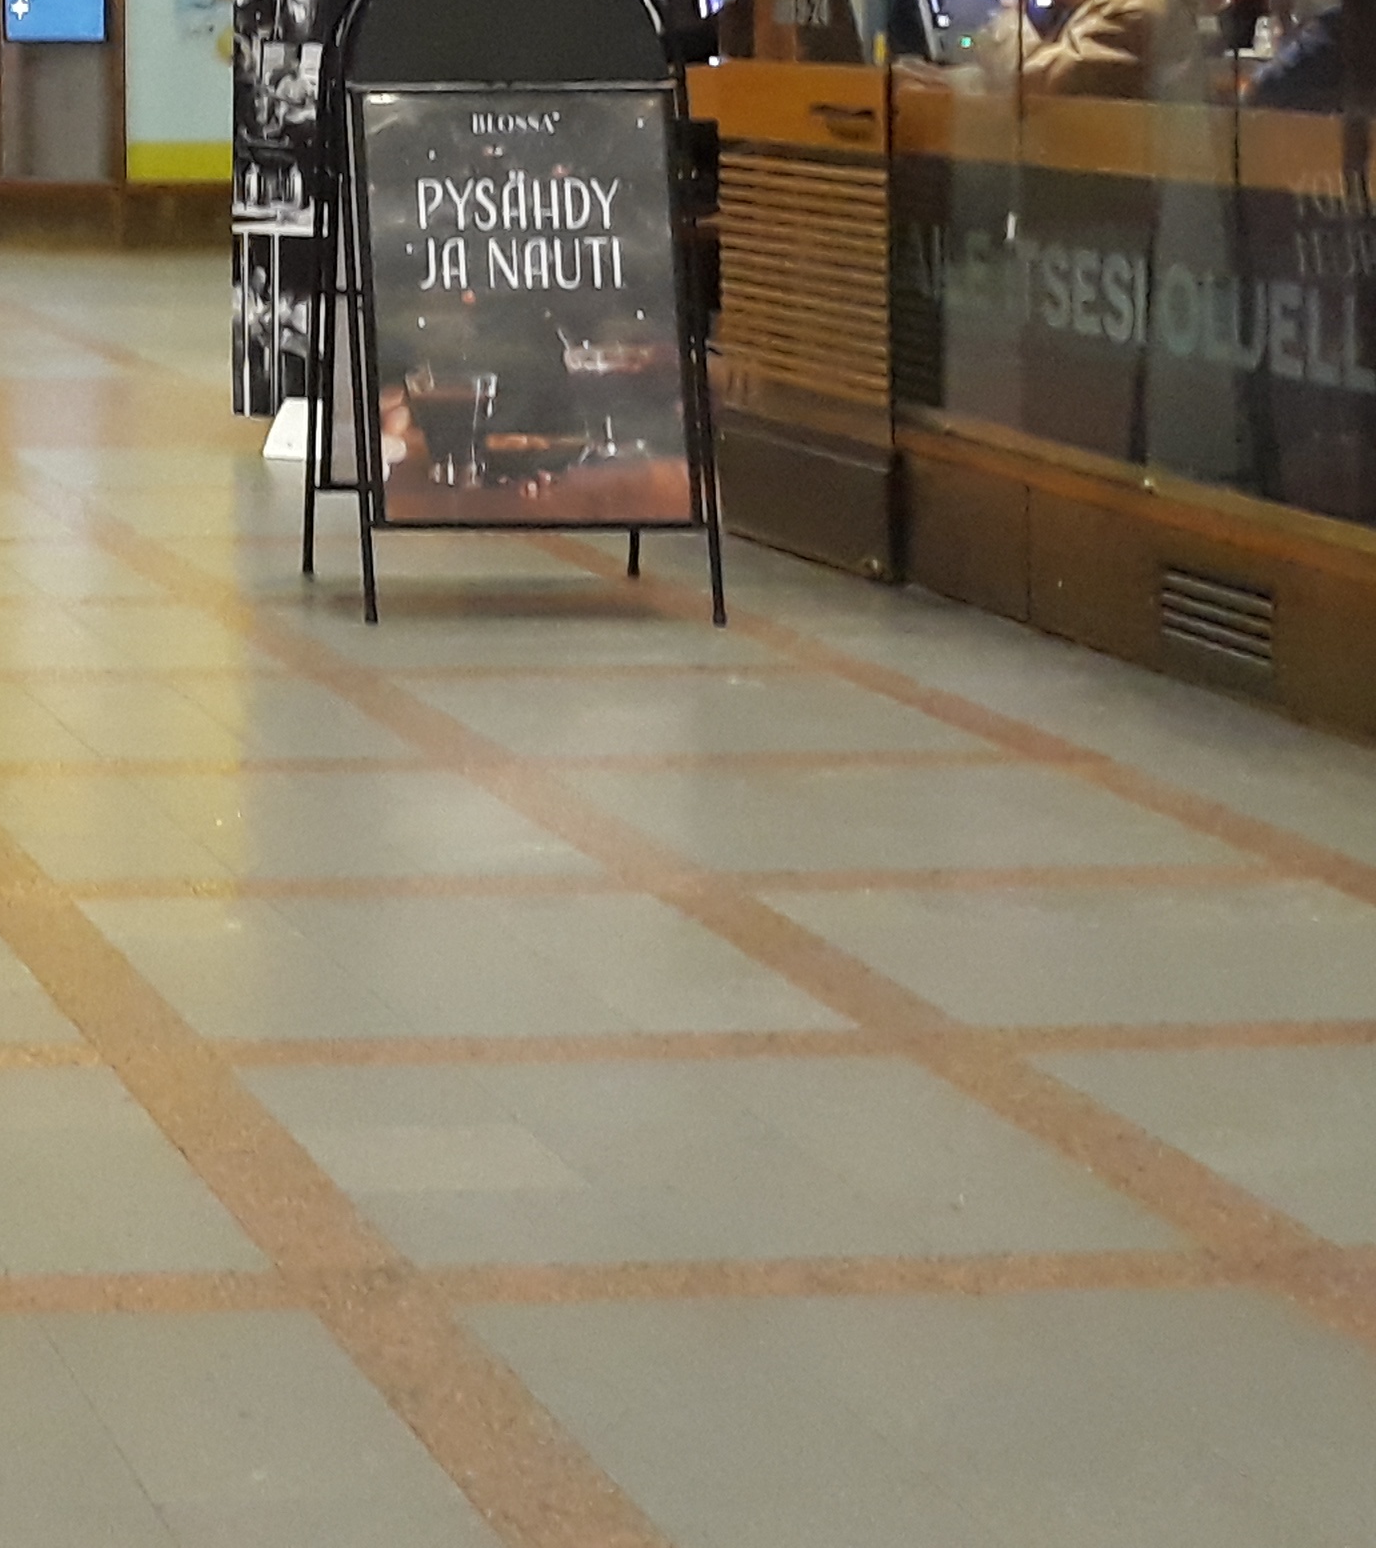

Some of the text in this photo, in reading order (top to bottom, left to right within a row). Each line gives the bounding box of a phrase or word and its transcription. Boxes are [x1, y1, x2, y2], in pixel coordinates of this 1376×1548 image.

[417, 169, 620, 232] PYSÄHDY
[420, 235, 623, 290] JA NAUTI
